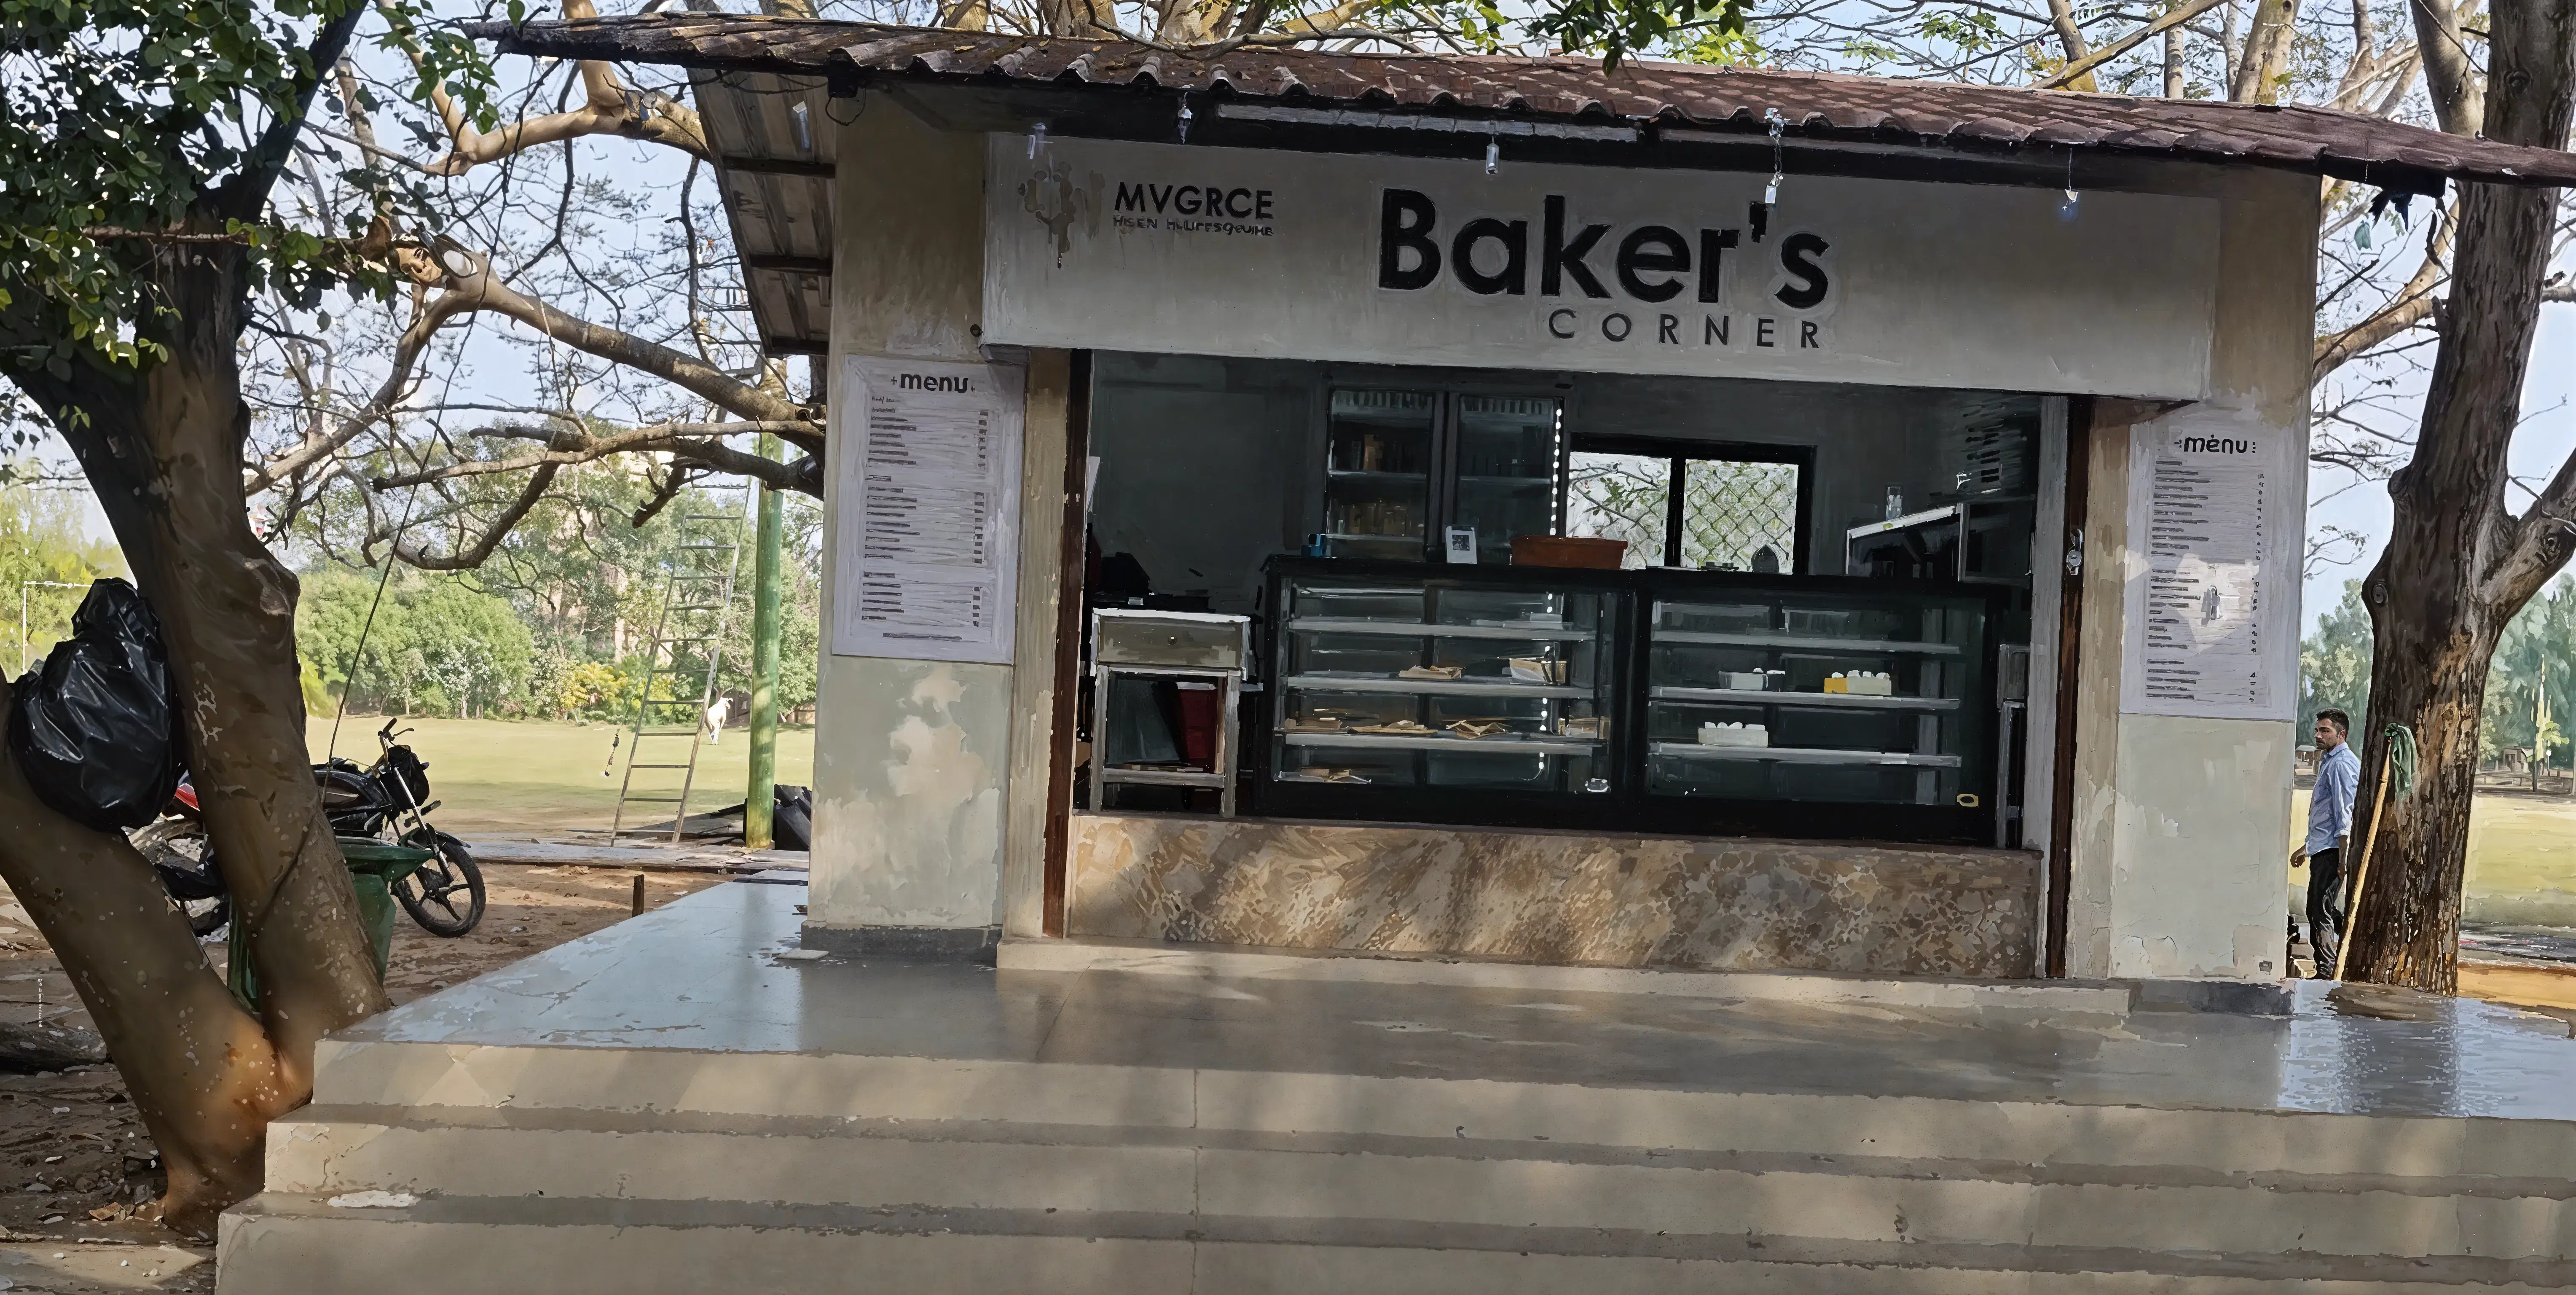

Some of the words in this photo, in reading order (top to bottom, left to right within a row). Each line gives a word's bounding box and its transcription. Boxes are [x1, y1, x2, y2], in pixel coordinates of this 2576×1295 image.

[1114, 181, 1274, 220] MVGRCE
[1379, 188, 1830, 309] Baker's
[1549, 308, 1819, 348] CORNER
[900, 373, 969, 394] menu
